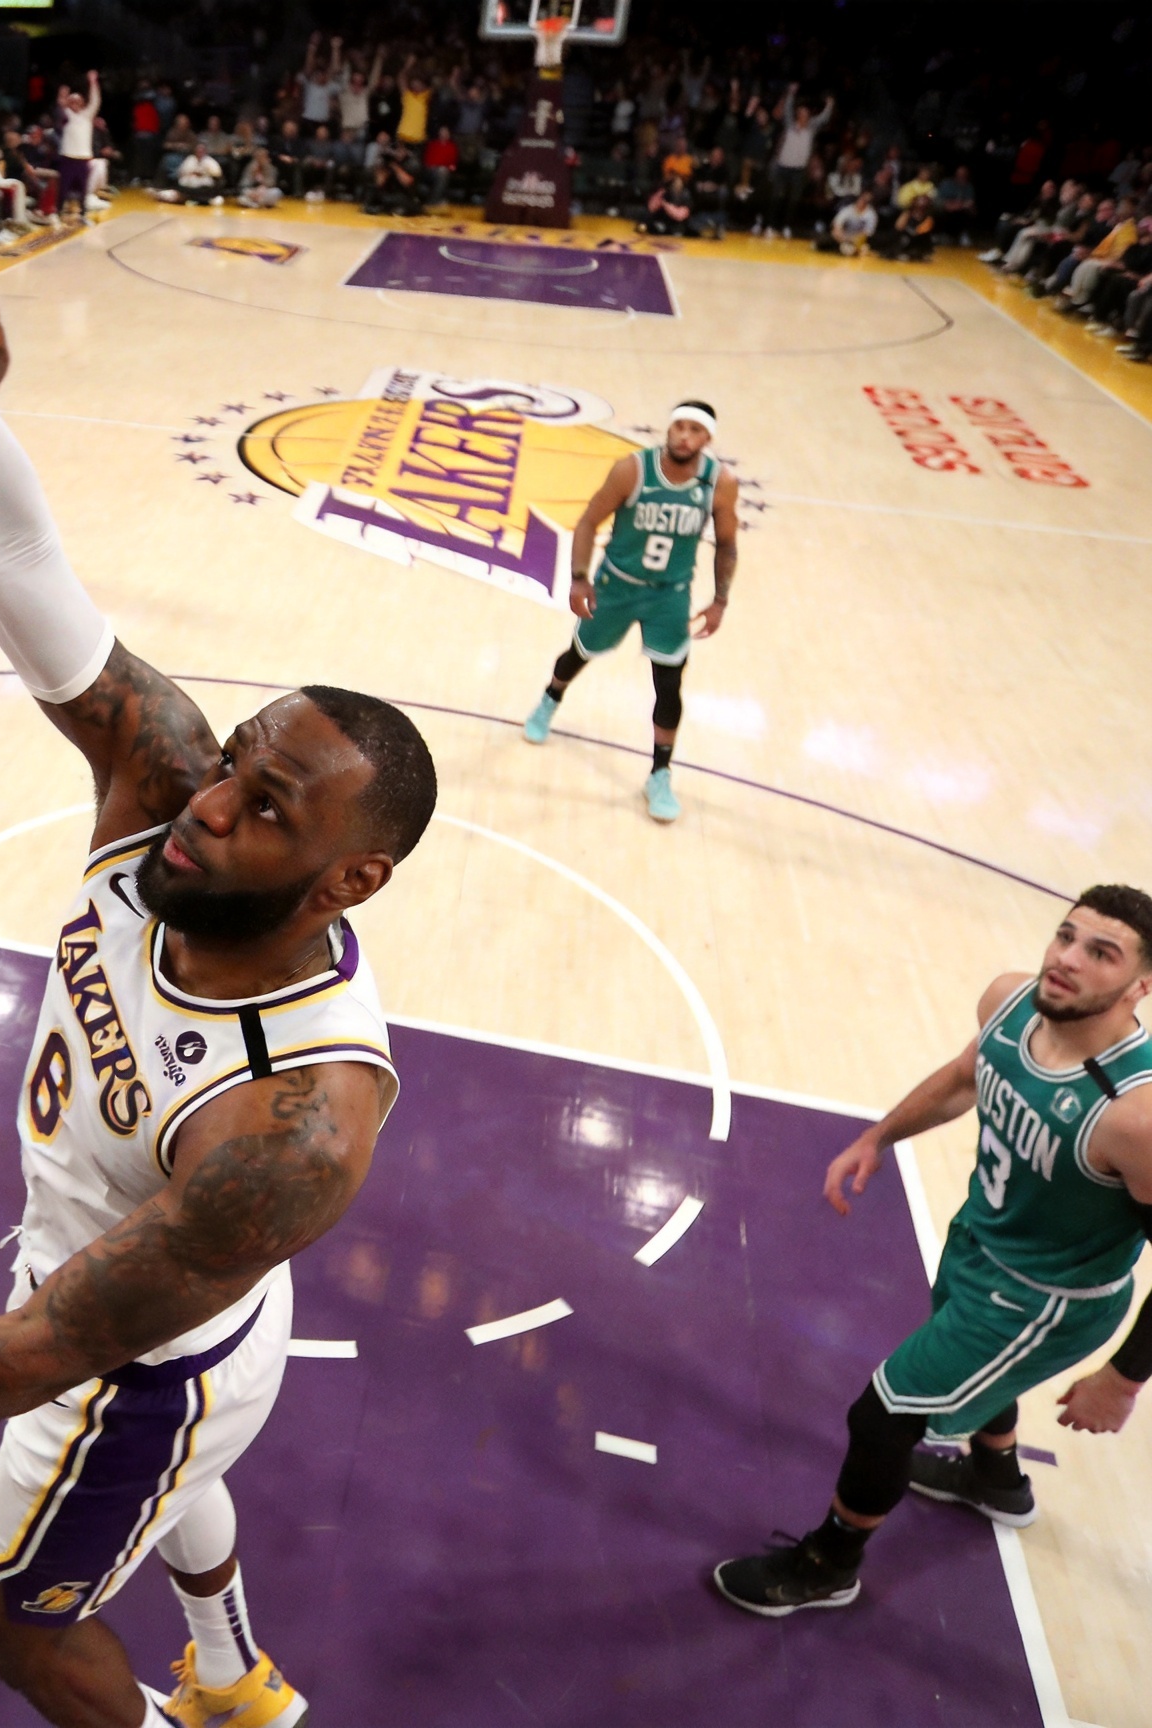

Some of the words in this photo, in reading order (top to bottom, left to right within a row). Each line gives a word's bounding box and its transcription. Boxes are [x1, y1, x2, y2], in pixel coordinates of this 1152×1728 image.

[315, 376, 581, 600] LAKERS
[633, 501, 704, 536] BOSTON
[56, 898, 152, 1138] LAKERS
[28, 1027, 74, 1144] 6
[977, 1124, 1012, 1210] 3
